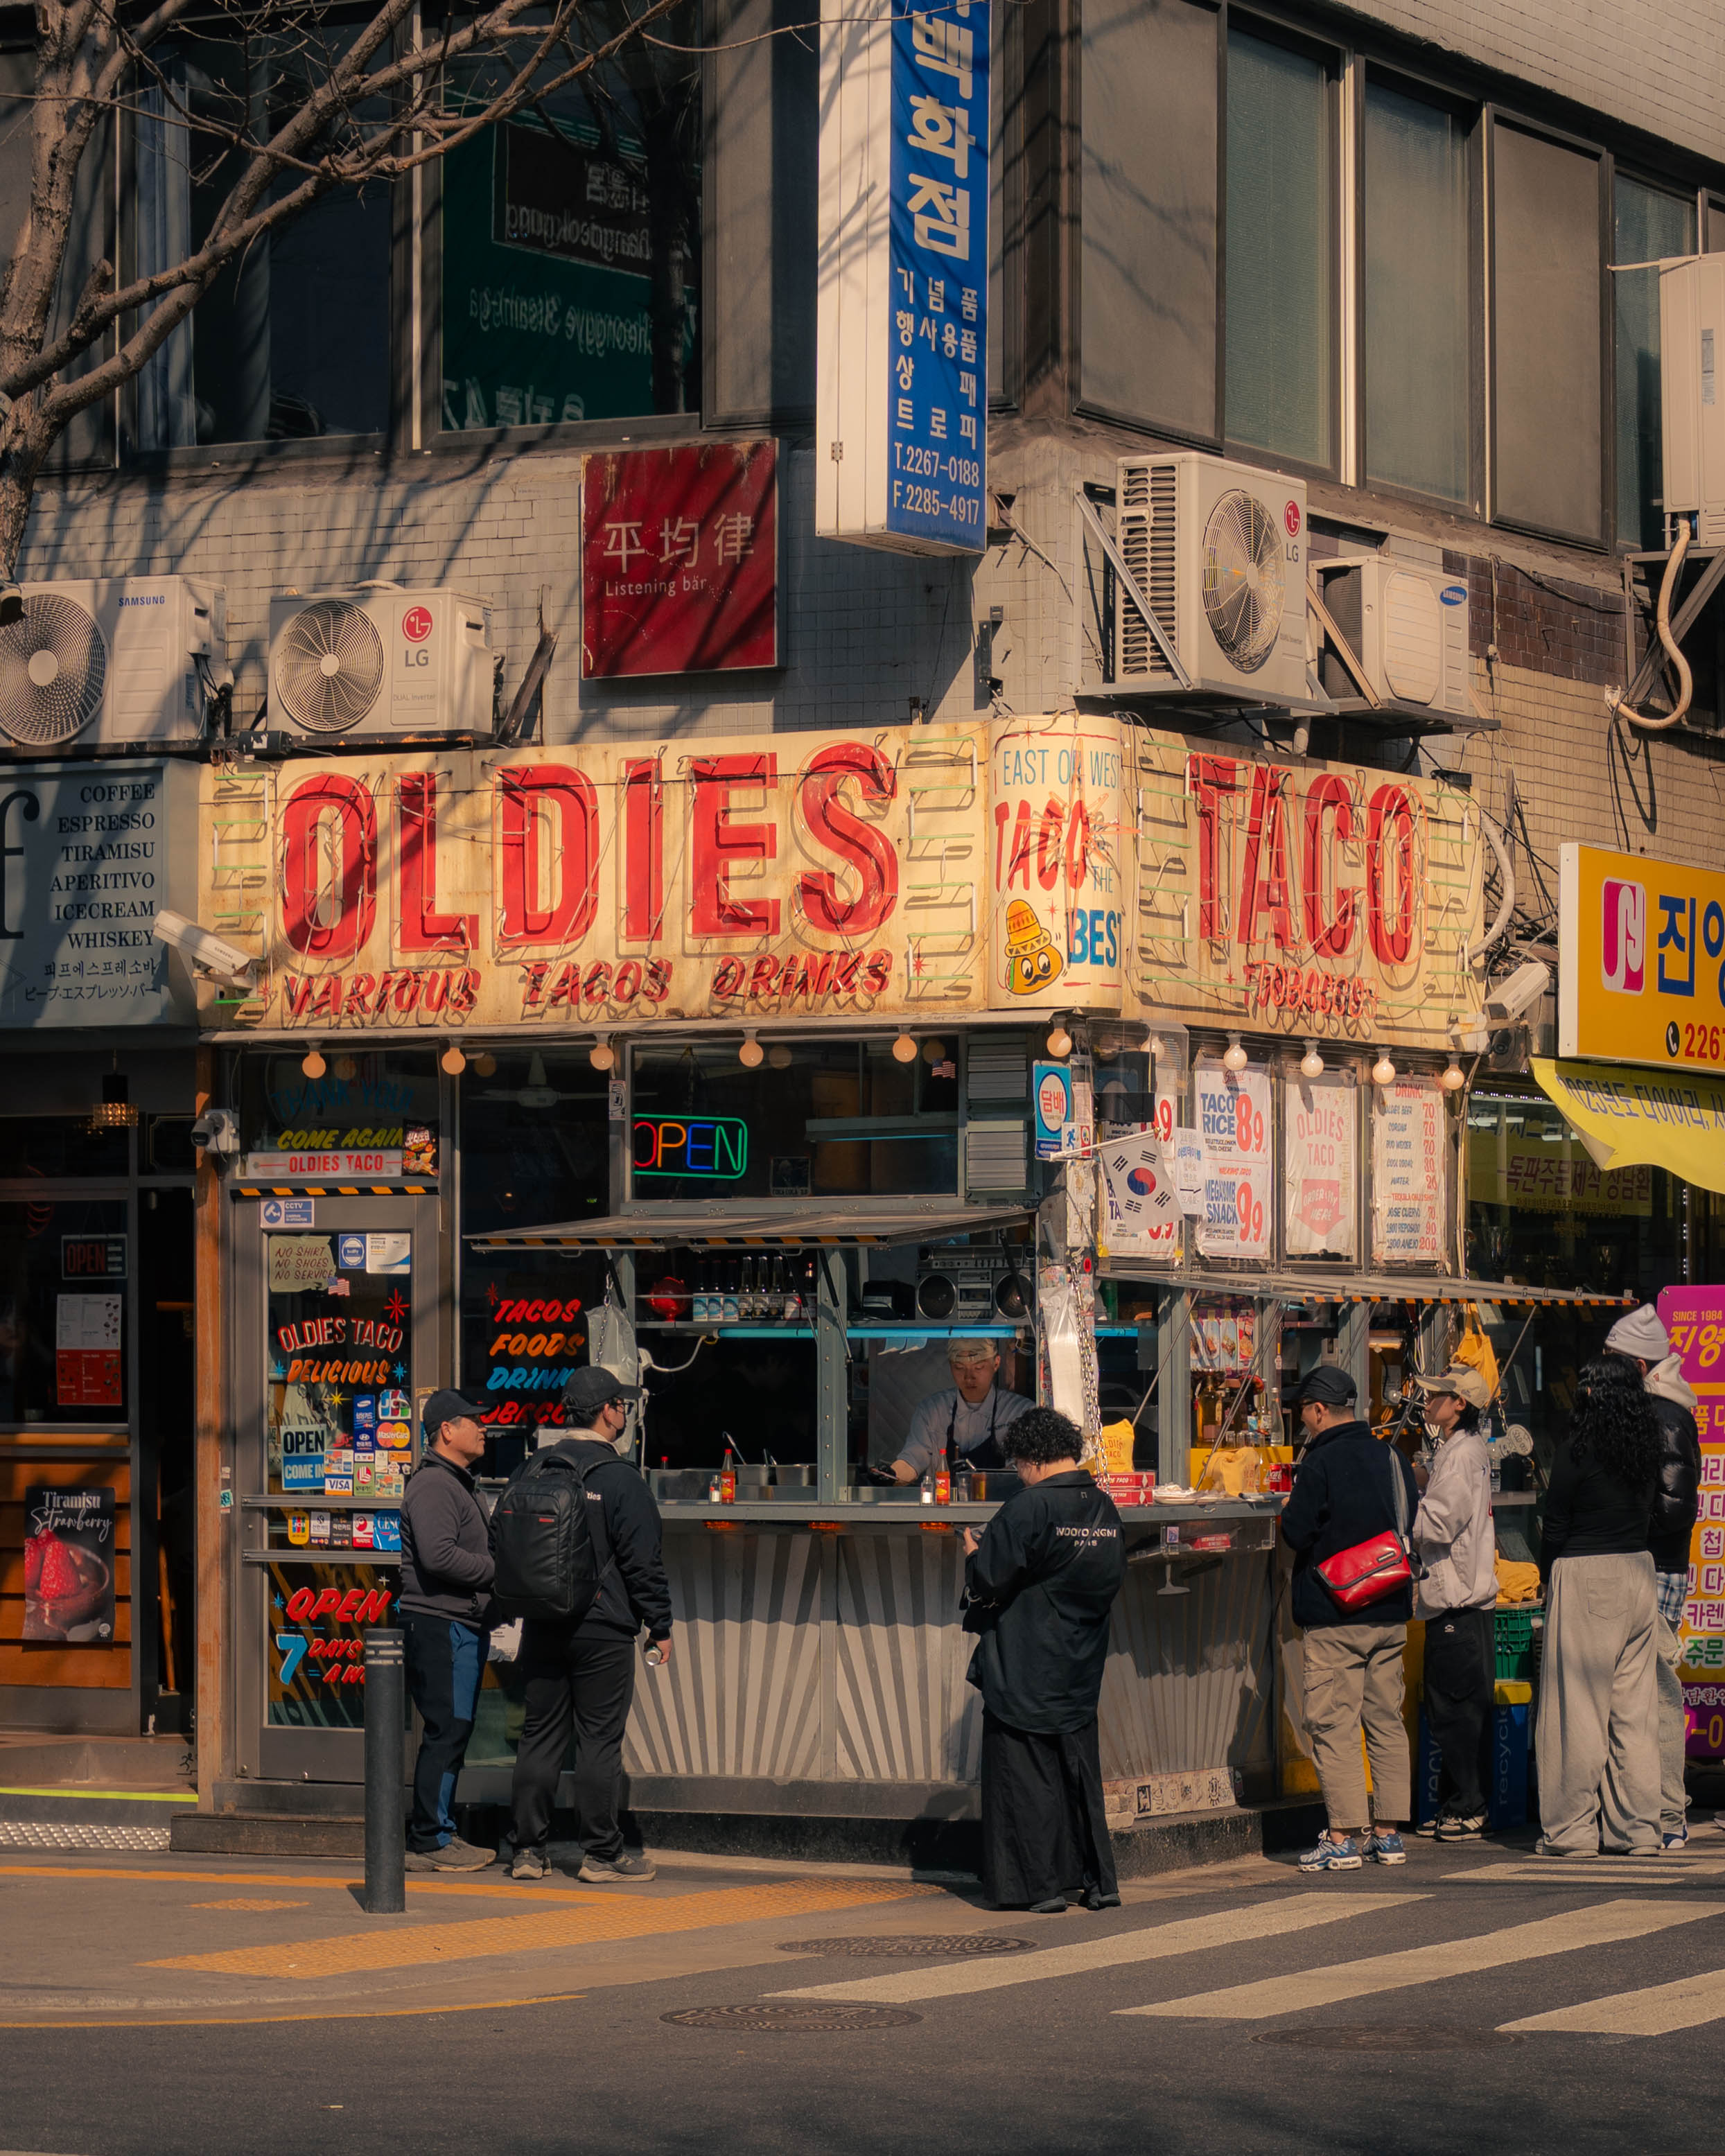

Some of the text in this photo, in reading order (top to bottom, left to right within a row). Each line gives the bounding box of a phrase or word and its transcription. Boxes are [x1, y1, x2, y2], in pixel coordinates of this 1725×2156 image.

[907, 0, 977, 261] 백화점
[897, 268, 979, 322] 기념품
[896, 310, 978, 364] 행사용품
[896, 398, 977, 450] 트로피
[893, 441, 980, 488] T.2267-0188
[893, 480, 980, 526] F.2285-4917
[603, 511, 755, 574] 平均律
[1286, 543, 1299, 563] LG
[606, 578, 676, 597] Listening
[118, 595, 166, 608] SAMSUNG
[405, 649, 429, 667] LG
[1004, 748, 1050, 787] EAST
[1090, 750, 1121, 790] WEST
[80, 783, 155, 804] COFFEE
[58, 812, 155, 833] ESPRESSO
[61, 842, 156, 862] TIRAMISU
[275, 739, 899, 959] OLDIES
[995, 799, 1088, 892] TACO
[1189, 752, 1429, 967] TACO
[49, 872, 155, 893] APERITIVO
[1093, 865, 1113, 893] THE
[55, 900, 155, 921] ICECREAM
[67, 929, 155, 949] WHISKEY
[1069, 908, 1121, 968] BEST
[281, 949, 894, 1017] VARIOUS TACOS DRINKS
[1041, 1089, 1065, 1114] 담배
[1200, 1093, 1236, 1114] TACO
[1202, 1113, 1236, 1135] RICE
[1297, 1107, 1345, 1142] OLDIES
[1388, 1122, 1407, 1132] CORONA
[277, 1129, 340, 1150] COME
[633, 1121, 743, 1171] OPEN
[288, 1154, 384, 1173] OLDIES TACO
[1306, 1142, 1335, 1166] TACO
[1390, 1177, 1410, 1186] WATER
[1303, 1187, 1324, 1207] ORDER
[1391, 1193, 1411, 1202] TEQUILA
[1206, 1202, 1238, 1225] SNACK
[1310, 1208, 1332, 1221] HERE
[1387, 1207, 1401, 1218] JOSE
[1401, 1207, 1421, 1218] CUERVO
[66, 1243, 106, 1273] OPEN
[274, 1246, 326, 1257] NO SHIRT
[274, 1258, 329, 1268] NO SHOES
[274, 1268, 335, 1280] NO SERVICE
[493, 1298, 582, 1323] TACOS
[1672, 1309, 1723, 1322] SINCE 1984
[277, 1317, 403, 1353] OLDIES TACO
[489, 1332, 586, 1358] FOODS
[286, 1359, 392, 1385] DELICIOUS
[487, 1366, 575, 1391] DRINK
[283, 1430, 325, 1454] OPEN
[378, 1431, 408, 1439] MasterCard
[284, 1463, 325, 1480] COME IN
[329, 1480, 350, 1490] VISA
[42, 1491, 101, 1509] Tiramisu
[30, 1506, 113, 1543] Strawberry
[286, 1586, 392, 1623] OPEN
[275, 1633, 308, 1686] 7
[308, 1638, 364, 1660] DAYS
[322, 1663, 342, 1684] A
